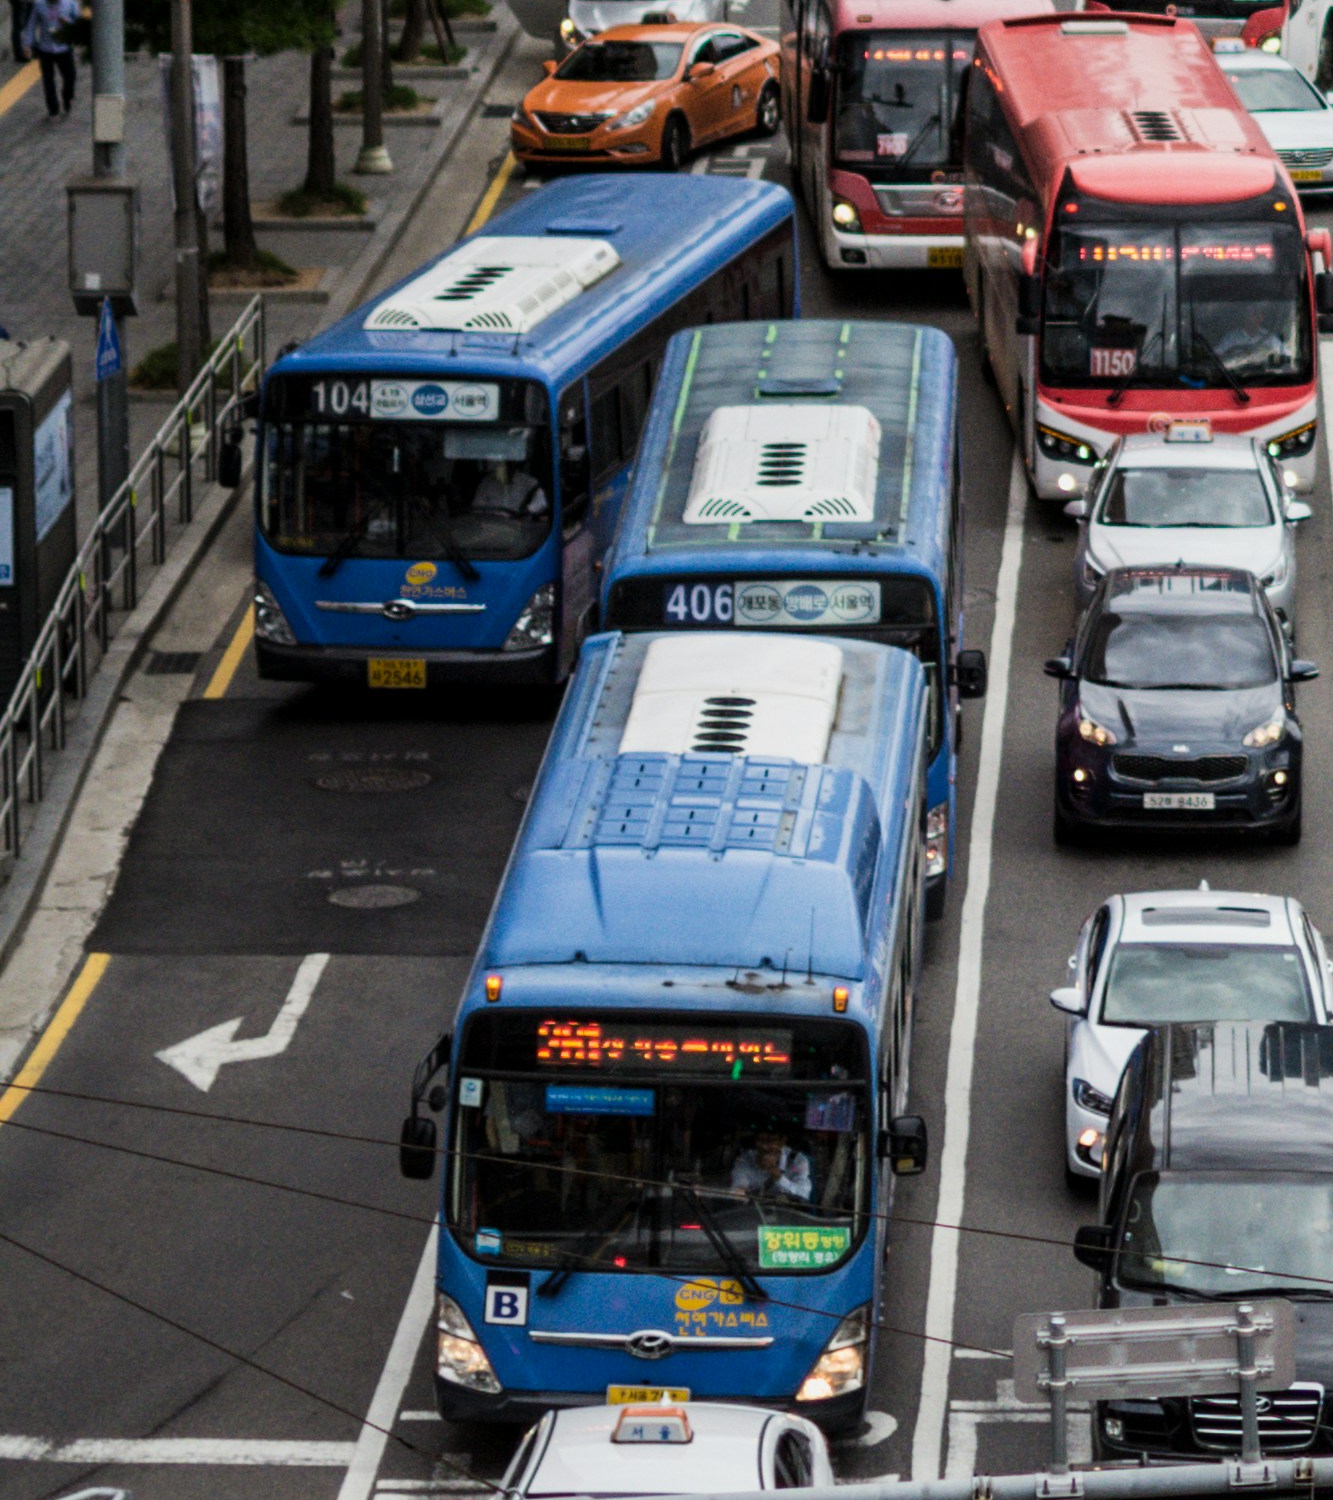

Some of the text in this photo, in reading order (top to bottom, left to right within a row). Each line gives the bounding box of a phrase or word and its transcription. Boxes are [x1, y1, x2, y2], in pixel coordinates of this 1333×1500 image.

[1094, 349, 1136, 376] 1150
[312, 383, 370, 414] 104
[452, 392, 488, 410] 서울역
[666, 584, 732, 620] 406
[739, 594, 781, 613] 개포동
[832, 592, 874, 614] 서울역
[493, 1292, 519, 1318] B
[680, 1289, 717, 1301] CNG
[675, 1312, 769, 1337] 천연가스버스
[632, 1426, 672, 1439] 서울
